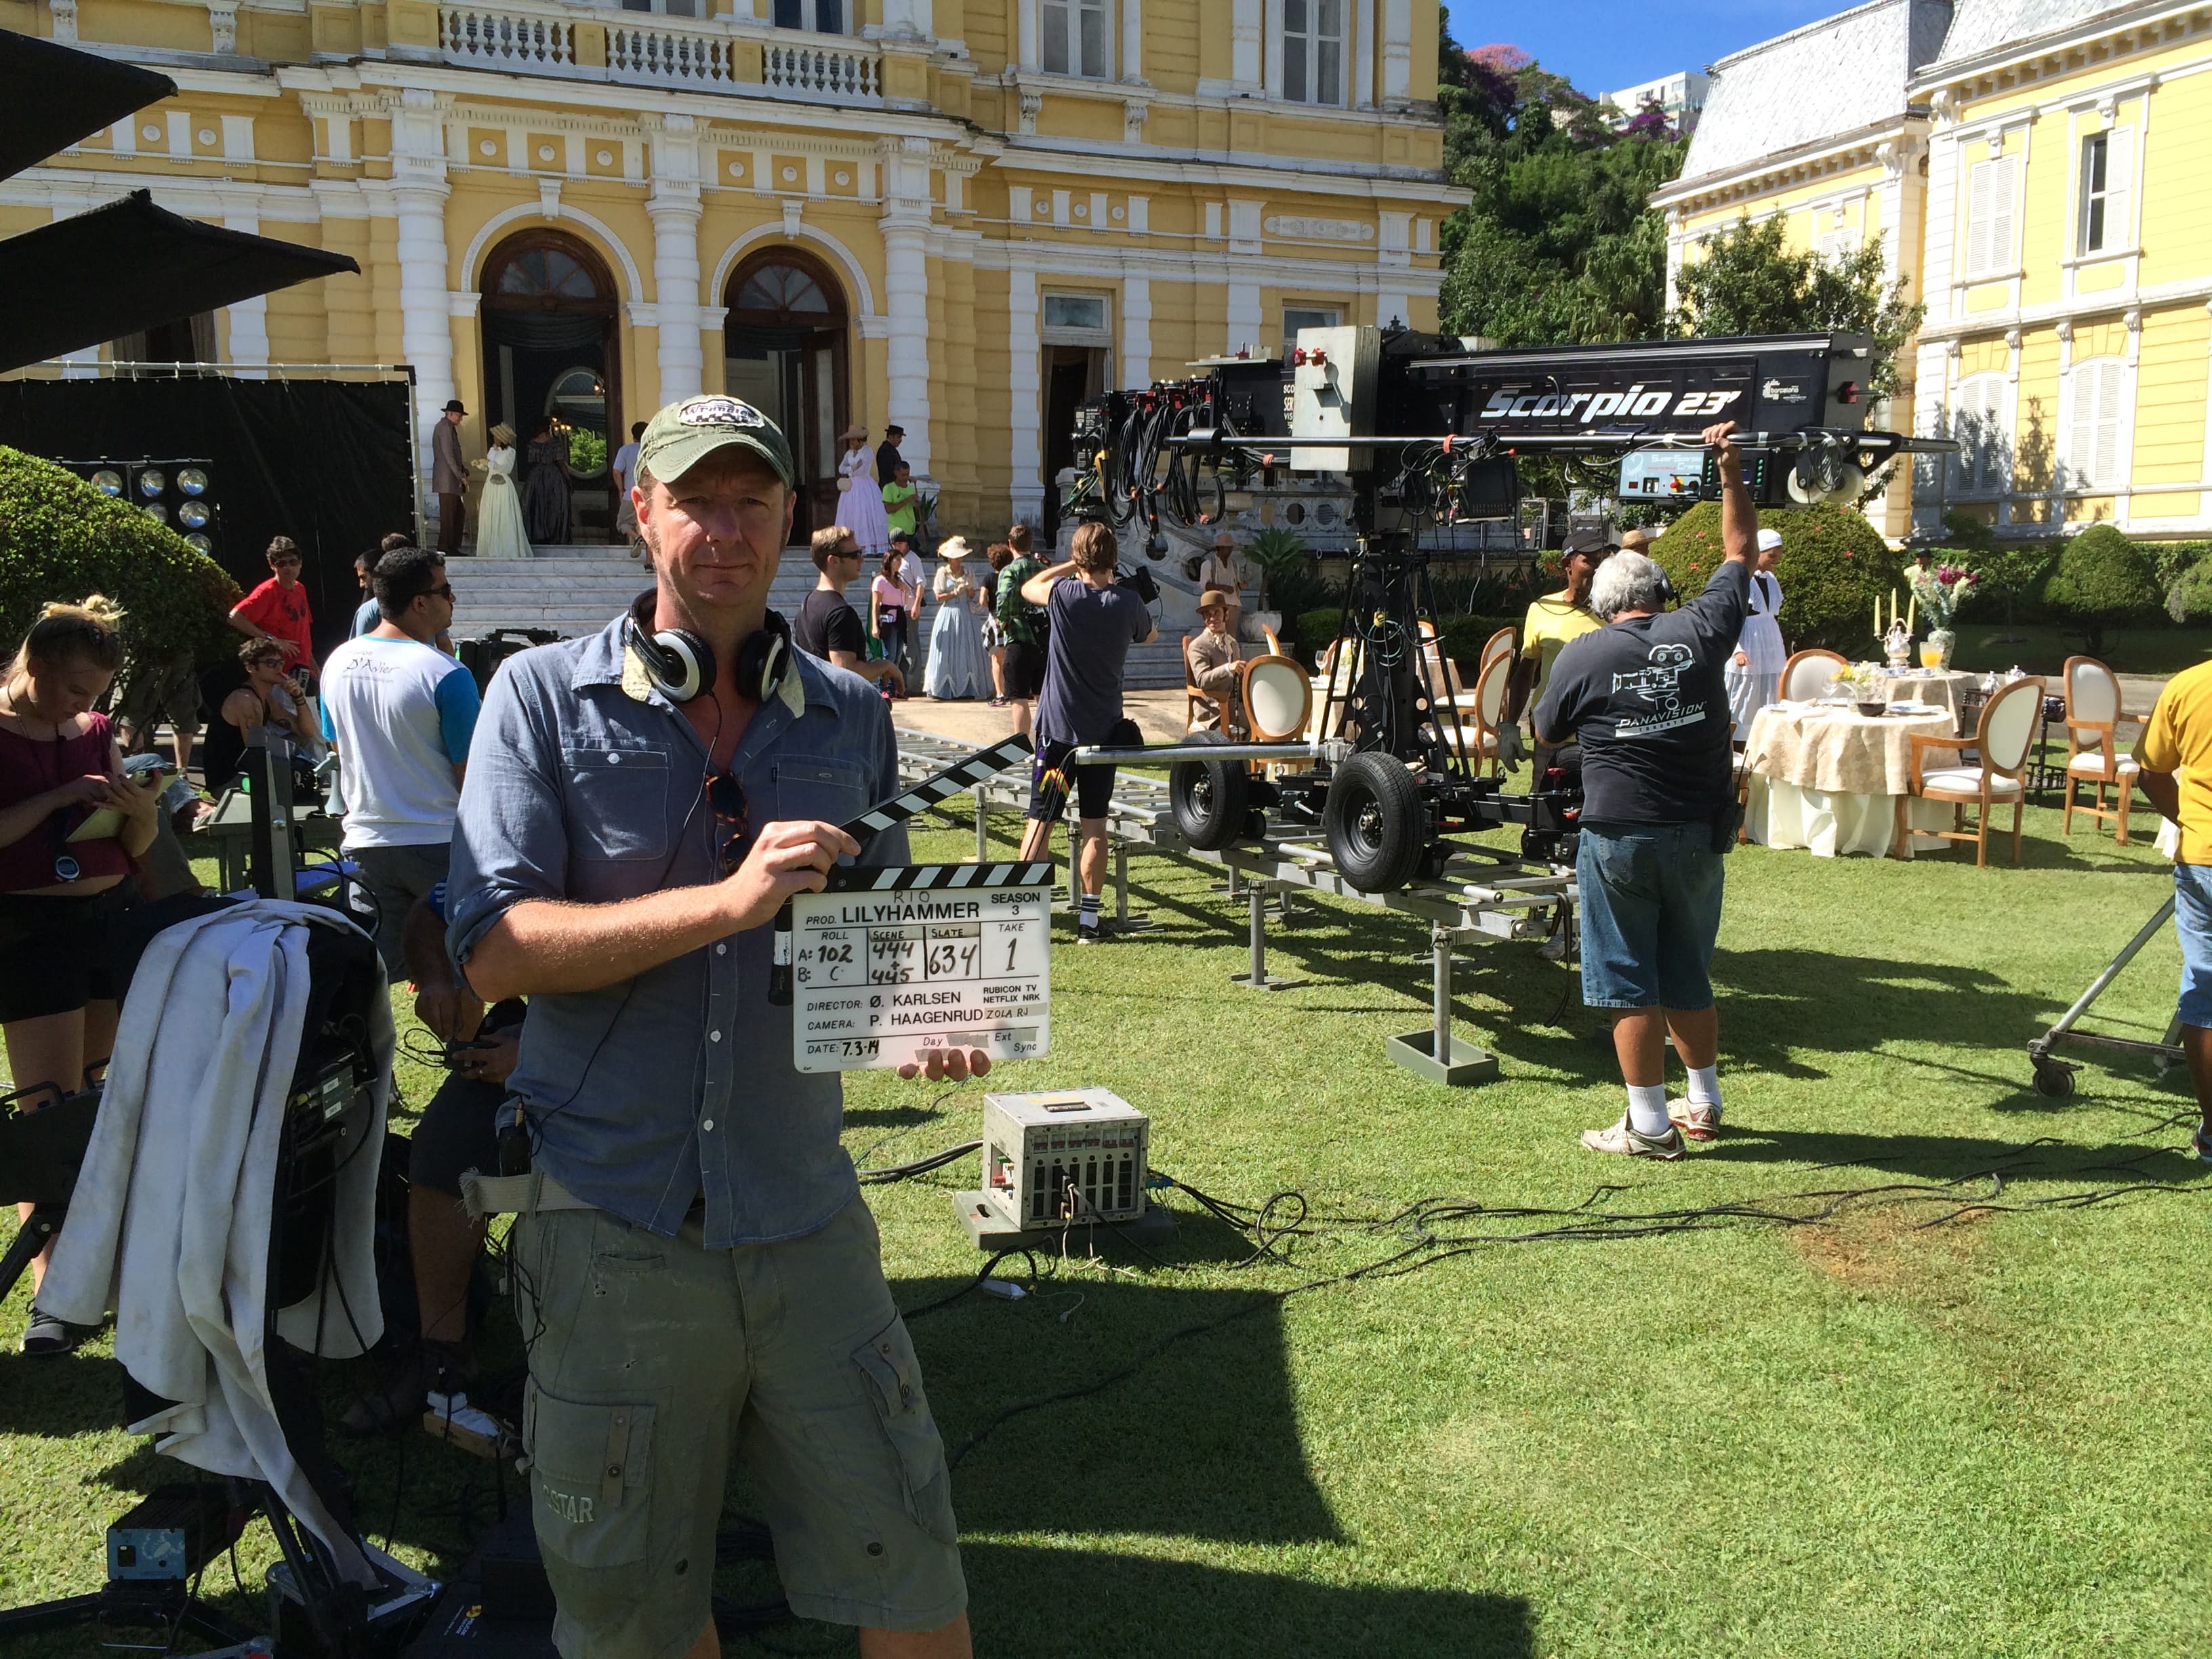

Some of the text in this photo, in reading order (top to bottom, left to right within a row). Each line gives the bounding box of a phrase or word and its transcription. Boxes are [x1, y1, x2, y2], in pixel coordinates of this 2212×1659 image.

[1480, 385, 1673, 424] Scorpio
[1615, 701, 1704, 728] PANAVISION
[893, 890, 930, 904] RIO
[991, 892, 1040, 903] SEASON
[806, 901, 980, 925] PROD. LILYHAMMER
[1012, 905, 1020, 915] 3
[931, 928, 964, 938] SLATE
[998, 923, 1025, 932] TAKE
[821, 931, 849, 941] ROLL
[872, 930, 905, 940] SCENE
[798, 948, 813, 962] A:
[818, 944, 853, 963] 102
[872, 941, 914, 960] 444
[1006, 938, 1017, 971] 1
[929, 944, 977, 977] 634
[798, 967, 812, 983] B:
[872, 967, 914, 985] 445
[983, 985, 1021, 994] RUBICON
[807, 1000, 863, 1012] DIRECTOR:
[893, 991, 961, 1007] KARLSEN
[983, 994, 1040, 1004] NETFLIX NRK
[807, 1008, 983, 1031] CAMERA: P. HAAGENRUD
[986, 1008, 1029, 1020] ZOLA RJ
[923, 1037, 943, 1047] Day
[995, 1032, 1012, 1042] Ext
[807, 1044, 840, 1054] DATE:
[1014, 1042, 1038, 1054] Sync
